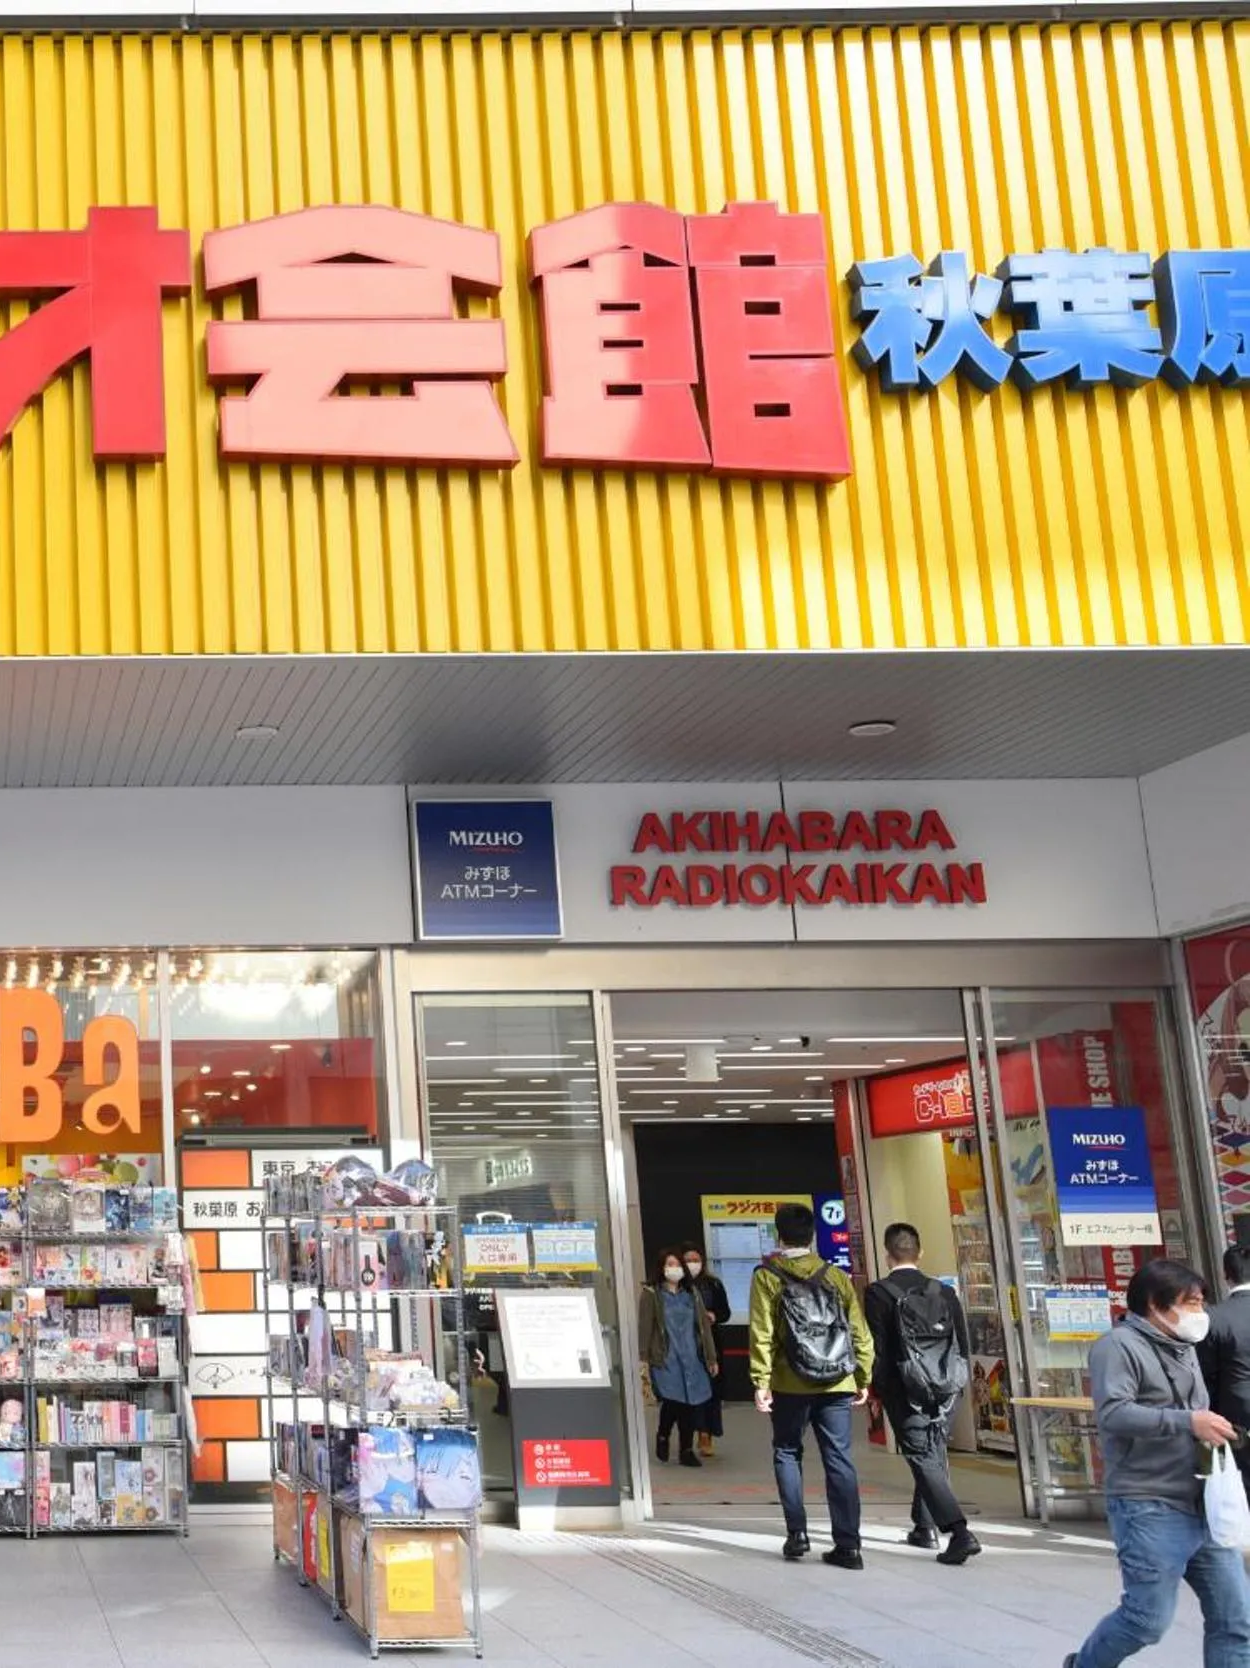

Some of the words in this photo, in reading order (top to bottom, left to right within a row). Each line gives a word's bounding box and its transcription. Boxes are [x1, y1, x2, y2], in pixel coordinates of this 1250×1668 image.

[449, 831, 523, 846] MIZUHO
[632, 810, 956, 853] AKIHABARA
[464, 866, 511, 880] みずほ
[440, 883, 537, 899] ATMコーナー
[609, 862, 988, 907] RADIOKAIKAN
[1072, 1133, 1126, 1147] MIZUHO
[1085, 1159, 1119, 1171] みずほ
[1069, 1172, 1139, 1185] ATMコーナー
[193, 1201, 239, 1218] 秋葉原
[727, 1200, 780, 1216] ラジオ会
